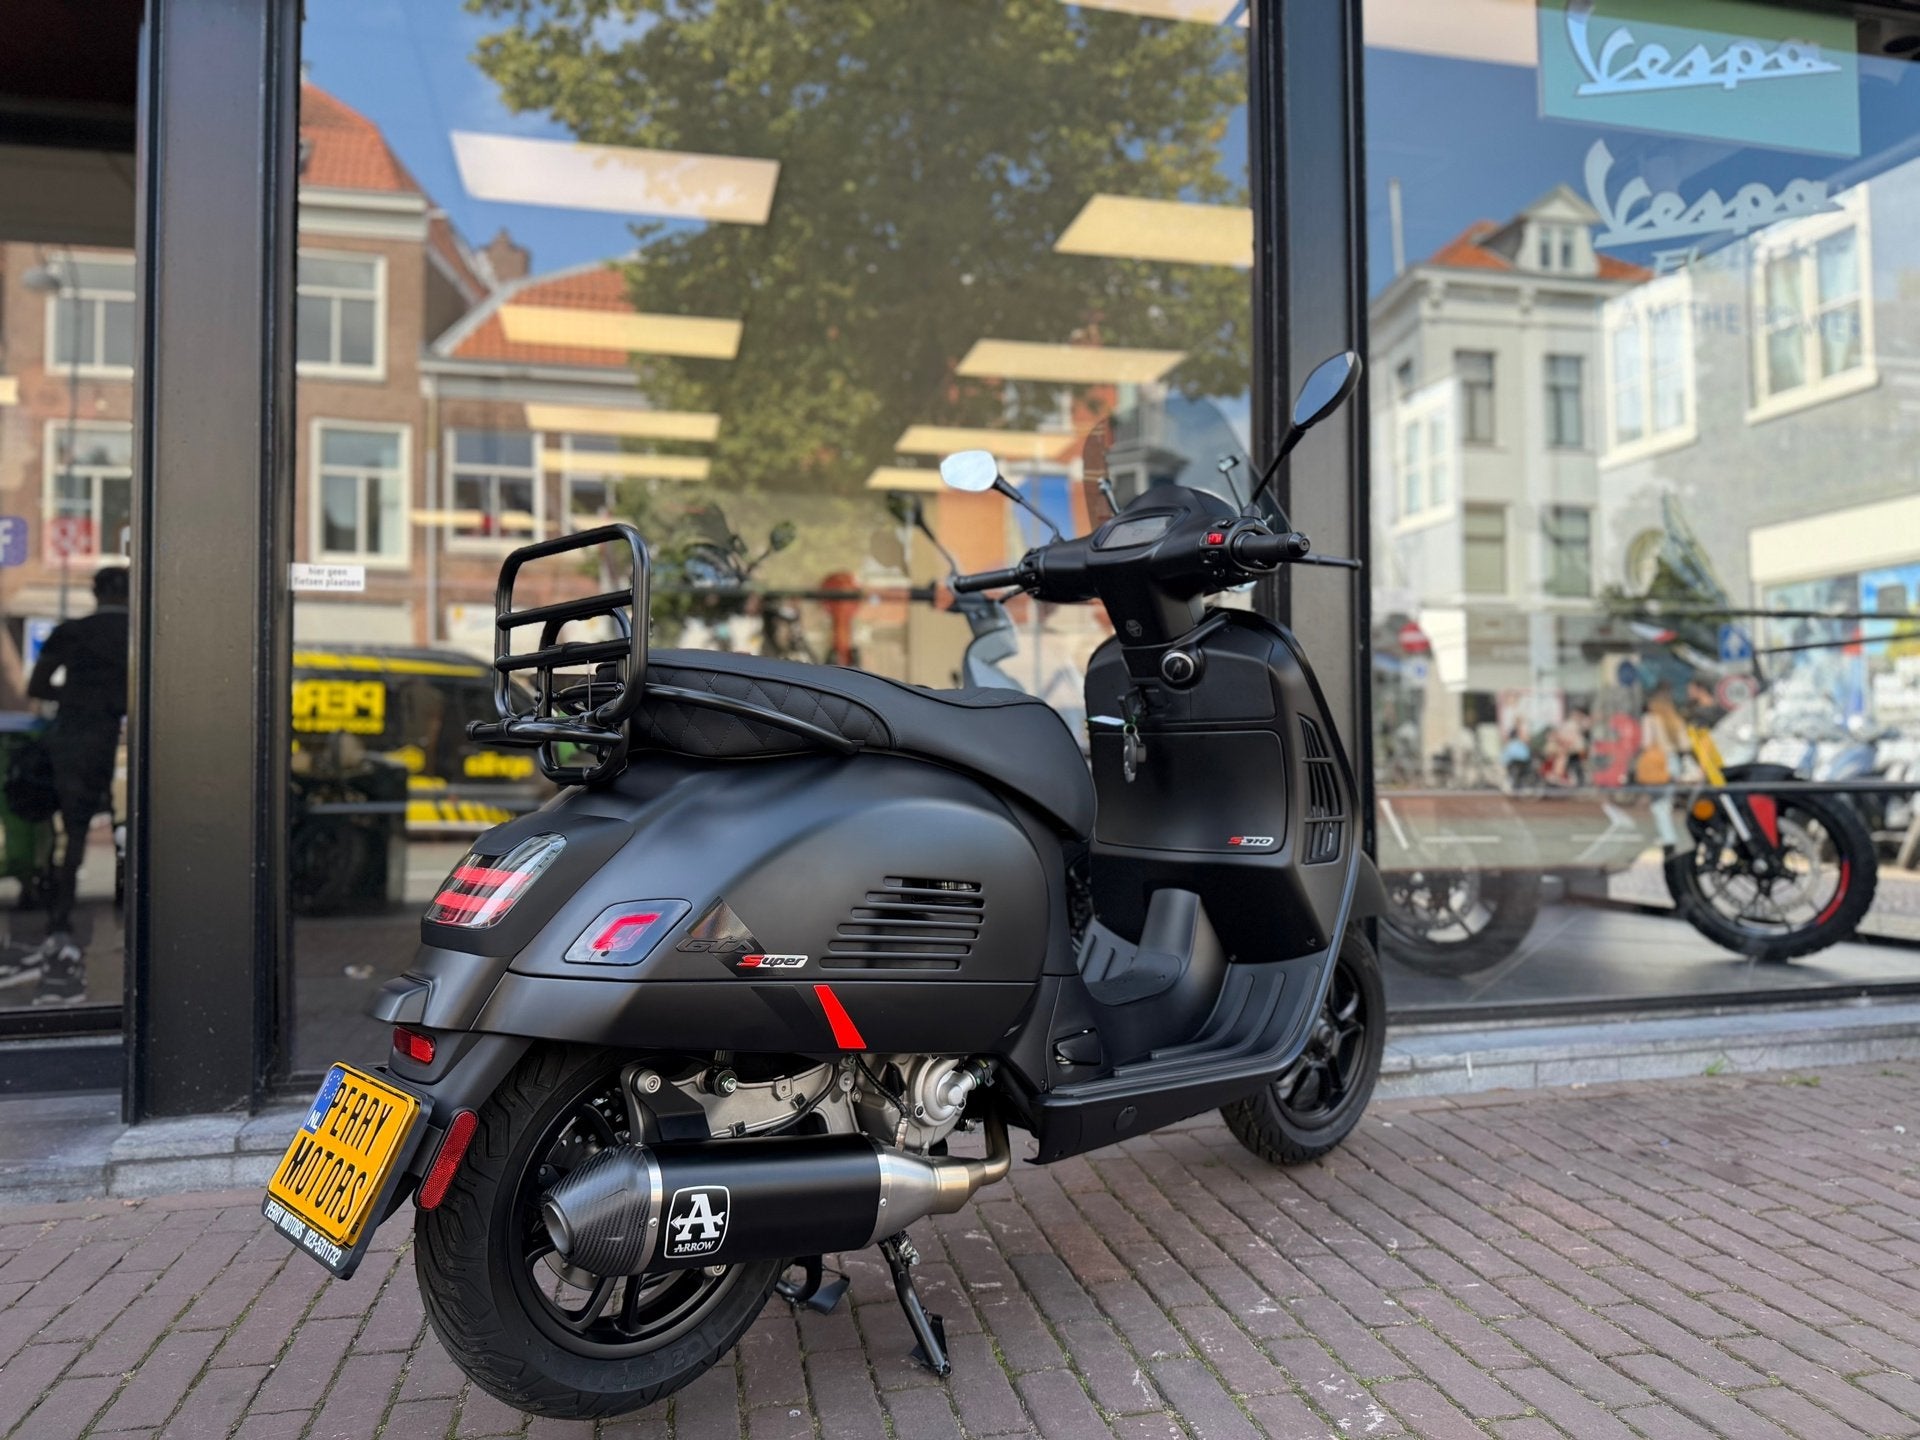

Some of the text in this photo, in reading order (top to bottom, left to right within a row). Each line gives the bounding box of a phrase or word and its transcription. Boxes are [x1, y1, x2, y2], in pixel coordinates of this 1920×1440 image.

[1567, 0, 1842, 96] Vespa
[1584, 138, 1845, 249] Vespa
[737, 954, 807, 968] Super
[307, 1109, 320, 1130] NL
[318, 1082, 394, 1157] PERRY
[279, 1136, 368, 1225] MOTORS
[264, 1200, 286, 1224] PERRY
[280, 1211, 306, 1240] MOTORS
[673, 1240, 715, 1253] ARROW
